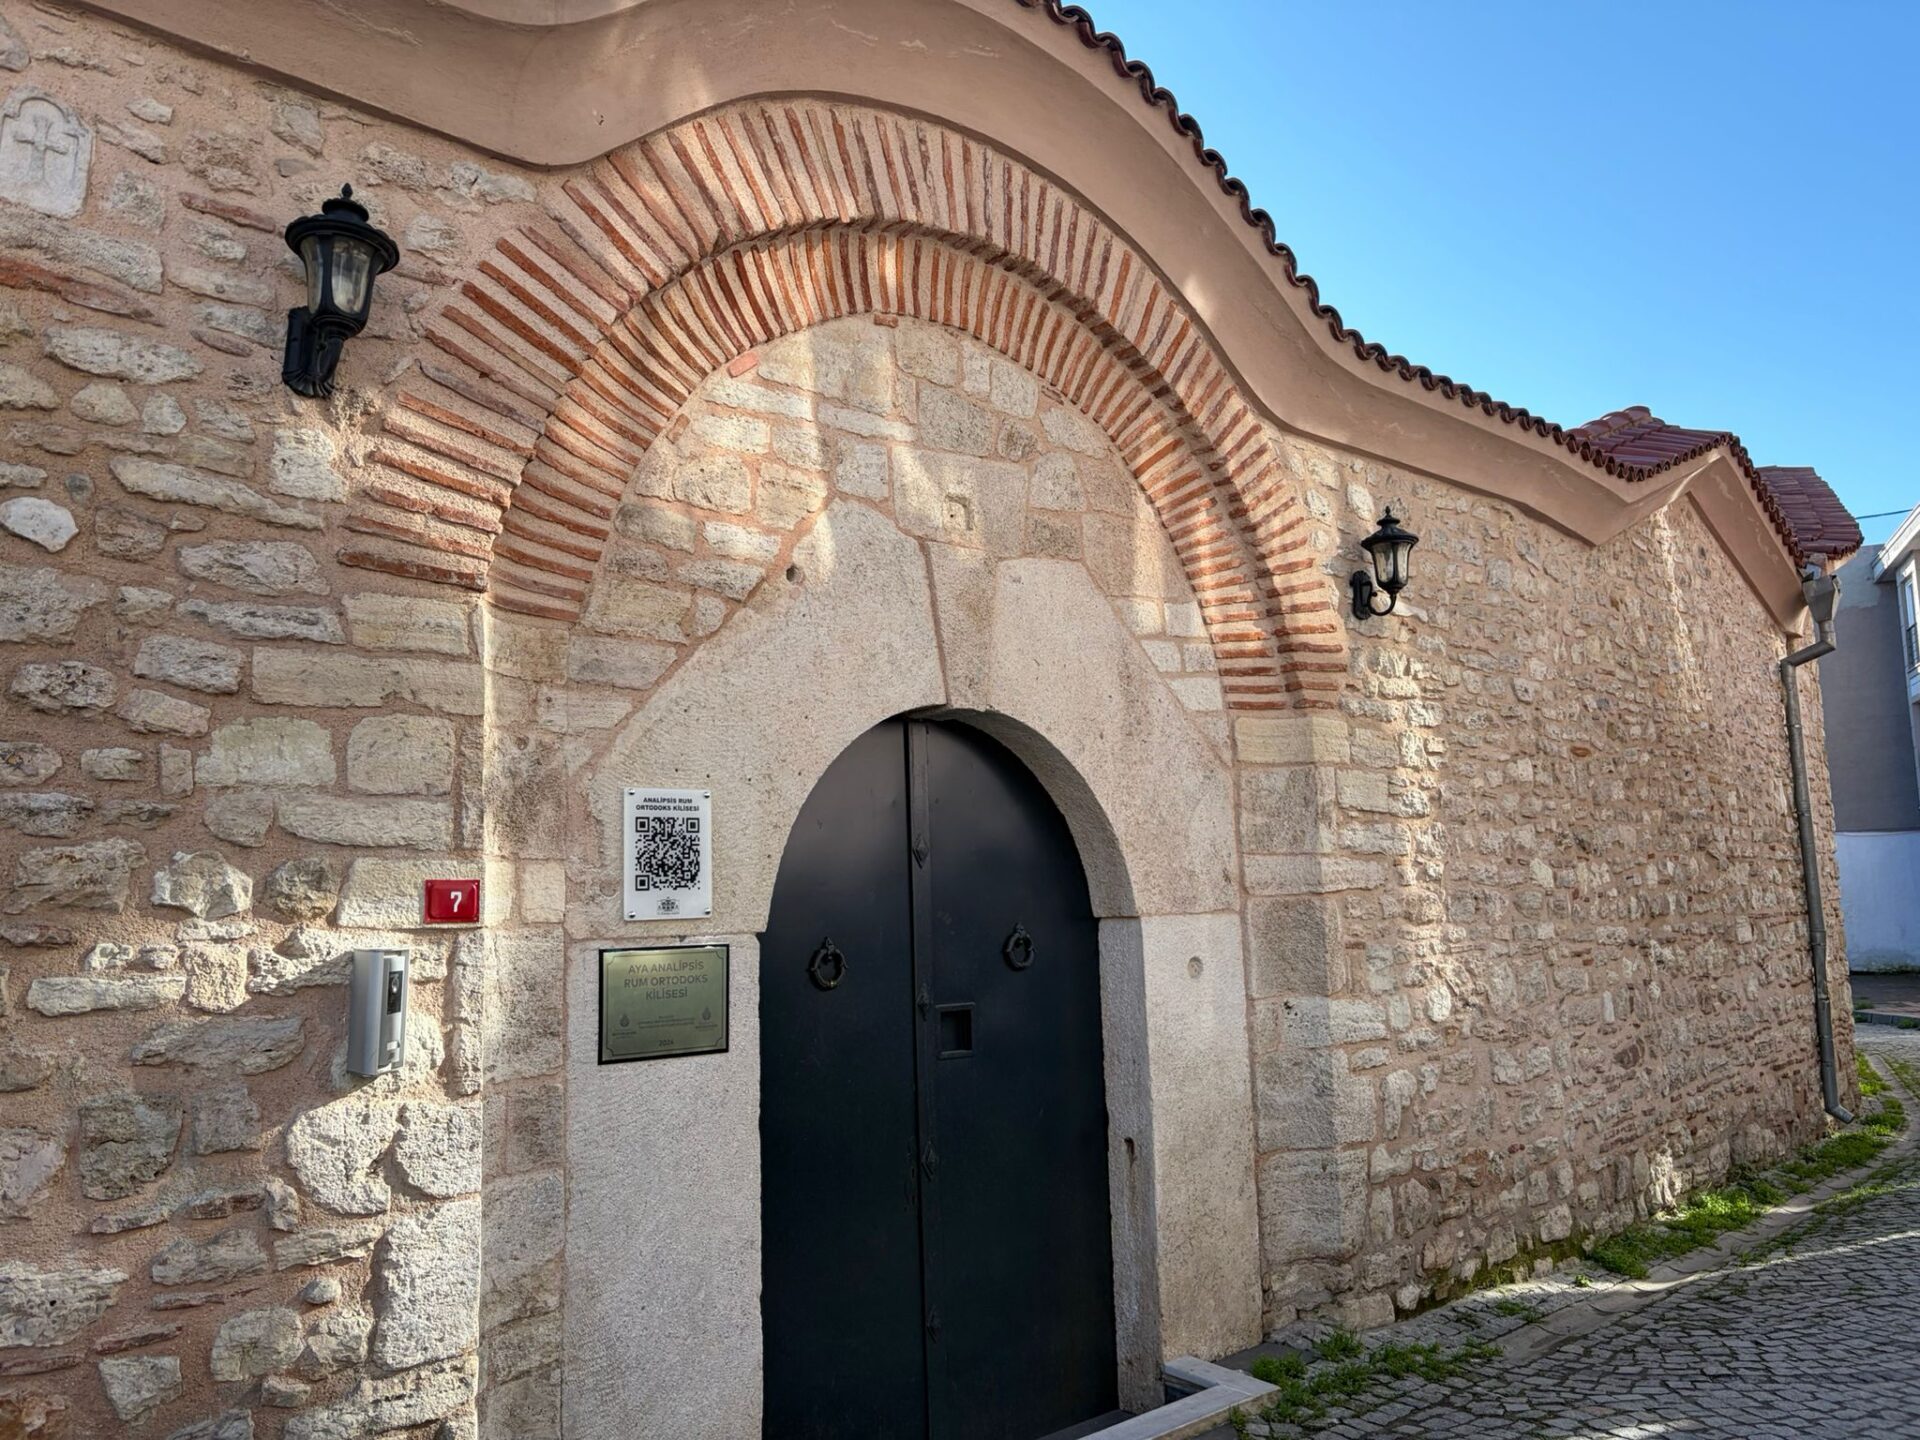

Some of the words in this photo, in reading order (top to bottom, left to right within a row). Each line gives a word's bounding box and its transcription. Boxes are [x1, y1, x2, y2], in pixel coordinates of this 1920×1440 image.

[450, 891, 462, 912] 7
[628, 964, 649, 975] AYA
[651, 960, 704, 972] ANALİPSİS
[624, 977, 649, 989] RUM
[651, 975, 708, 986] ORTODOKS
[646, 987, 688, 1000] KİLİSESİ
